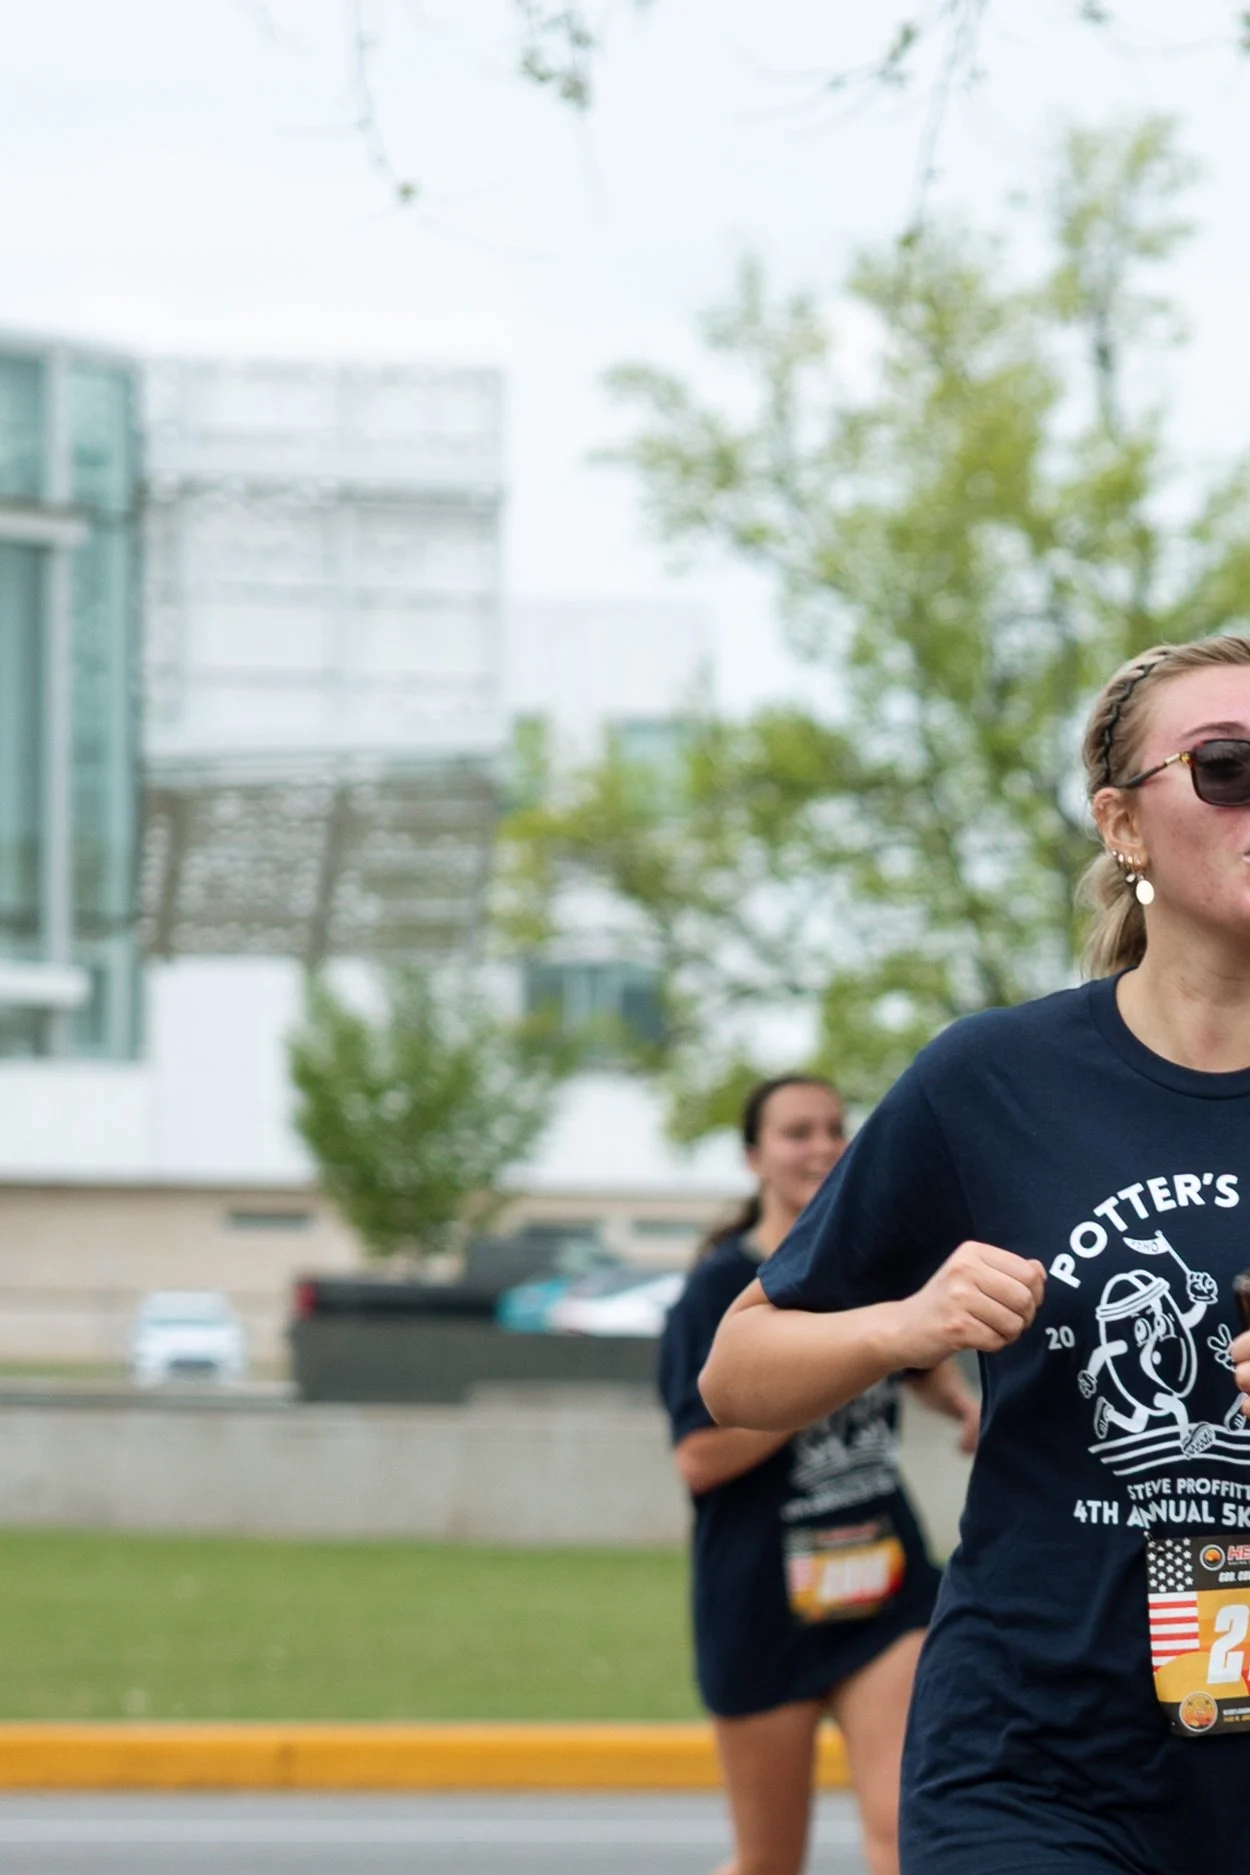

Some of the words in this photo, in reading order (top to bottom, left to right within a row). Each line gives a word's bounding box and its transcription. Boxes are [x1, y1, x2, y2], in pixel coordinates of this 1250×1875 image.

[1049, 1173, 1240, 1288] POTTER'S
[1045, 1325, 1075, 1350] 20
[1126, 1478, 1172, 1500] STEVE
[1073, 1499, 1119, 1525] 4TH
